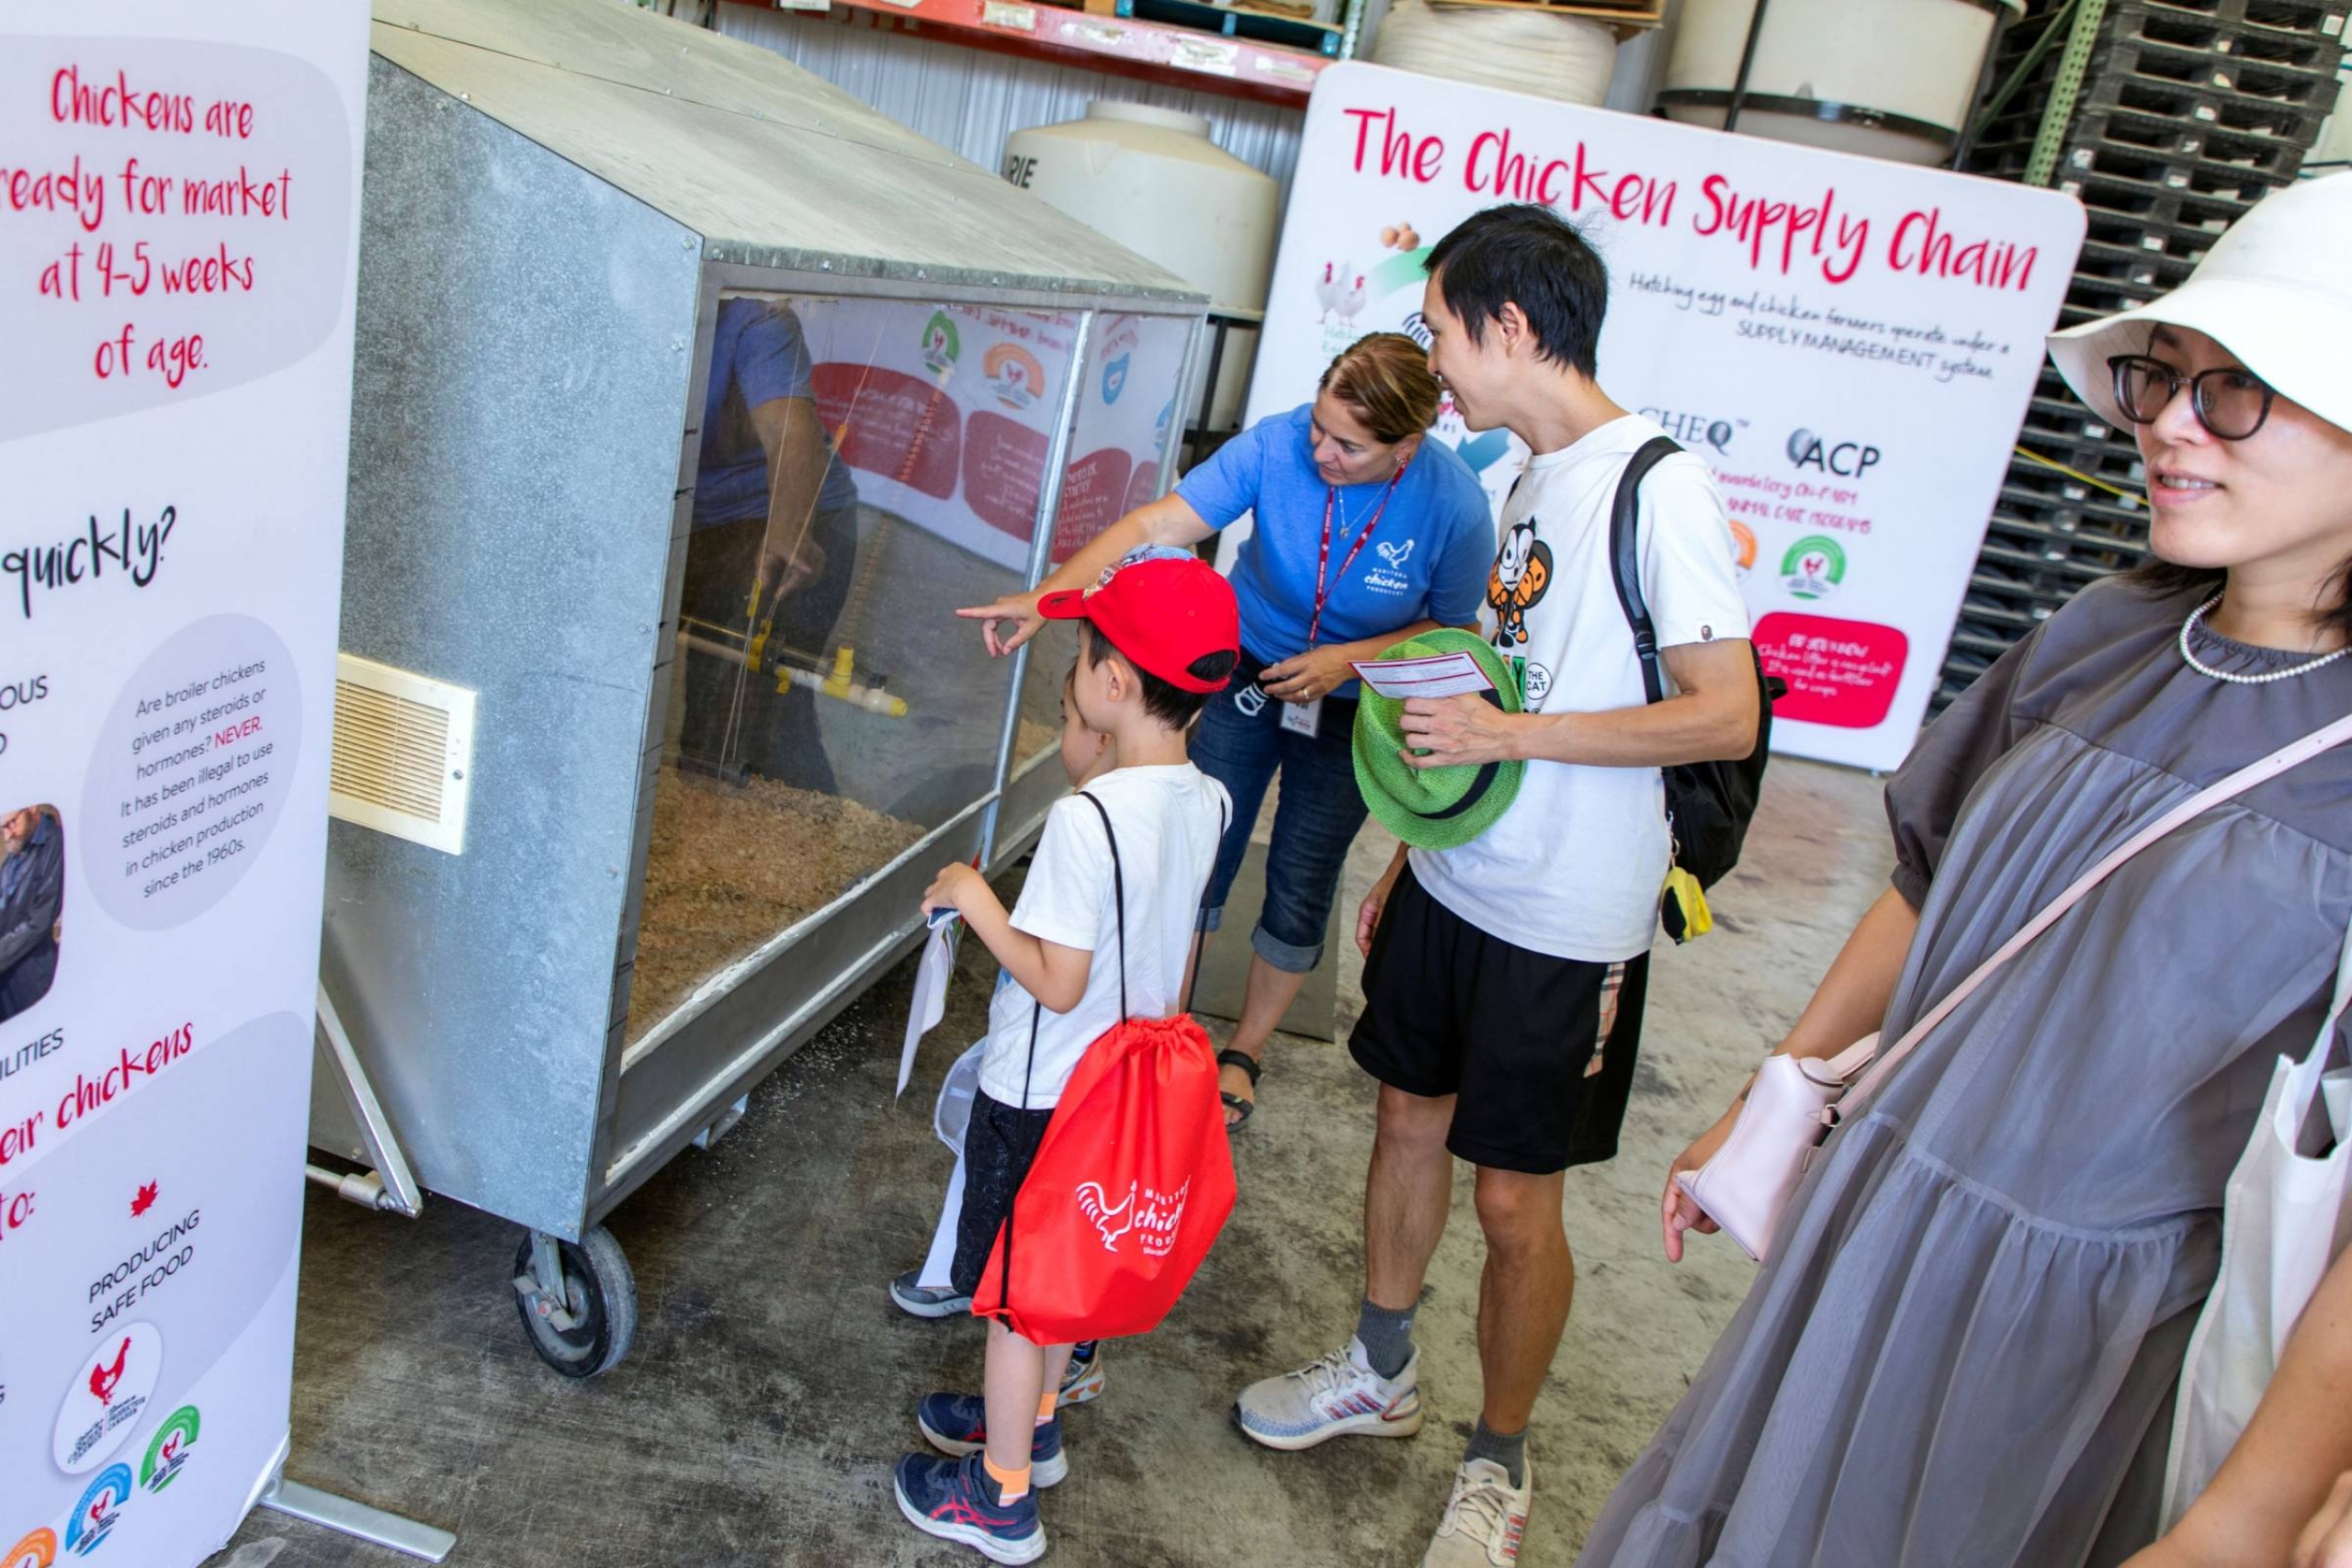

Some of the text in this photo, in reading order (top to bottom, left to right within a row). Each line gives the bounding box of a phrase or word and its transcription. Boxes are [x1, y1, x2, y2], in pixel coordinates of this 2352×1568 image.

[51, 64, 254, 139] Chickens are
[119, 158, 175, 215] for
[184, 165, 293, 220] market
[1343, 107, 2038, 292] The Chicken Supply Chain
[40, 243, 254, 301] at 4-5 weeks
[1629, 272, 1695, 310] Hatching
[1698, 291, 1726, 316] egg
[1730, 291, 1758, 315] and
[1759, 293, 1822, 321] chicken
[1826, 308, 1884, 334] farmers
[1890, 325, 1946, 343] operate
[1952, 331, 1995, 354] under
[1735, 320, 1802, 345] SUPPLY
[1802, 333, 1937, 368] MANAGEMENT
[96, 323, 208, 389] of age.
[1795, 438, 1881, 479] ACP
[1, 505, 176, 619] quickly?
[135, 659, 266, 718] Are broiler chickens
[1526, 681, 1546, 691] CAT
[1528, 671, 1544, 681] THE
[132, 689, 266, 754] given any steroids or
[137, 716, 262, 780] hormones? NEVER.
[120, 742, 273, 818] It has been illegal to use
[122, 772, 268, 848] steroids and hormones
[126, 800, 264, 877] in chicken production
[144, 836, 245, 897] since the 1960s.
[56, 1022, 193, 1129] chickens
[89, 1209, 200, 1303] PRODUCING
[91, 1246, 194, 1333] SAFE FOOD
